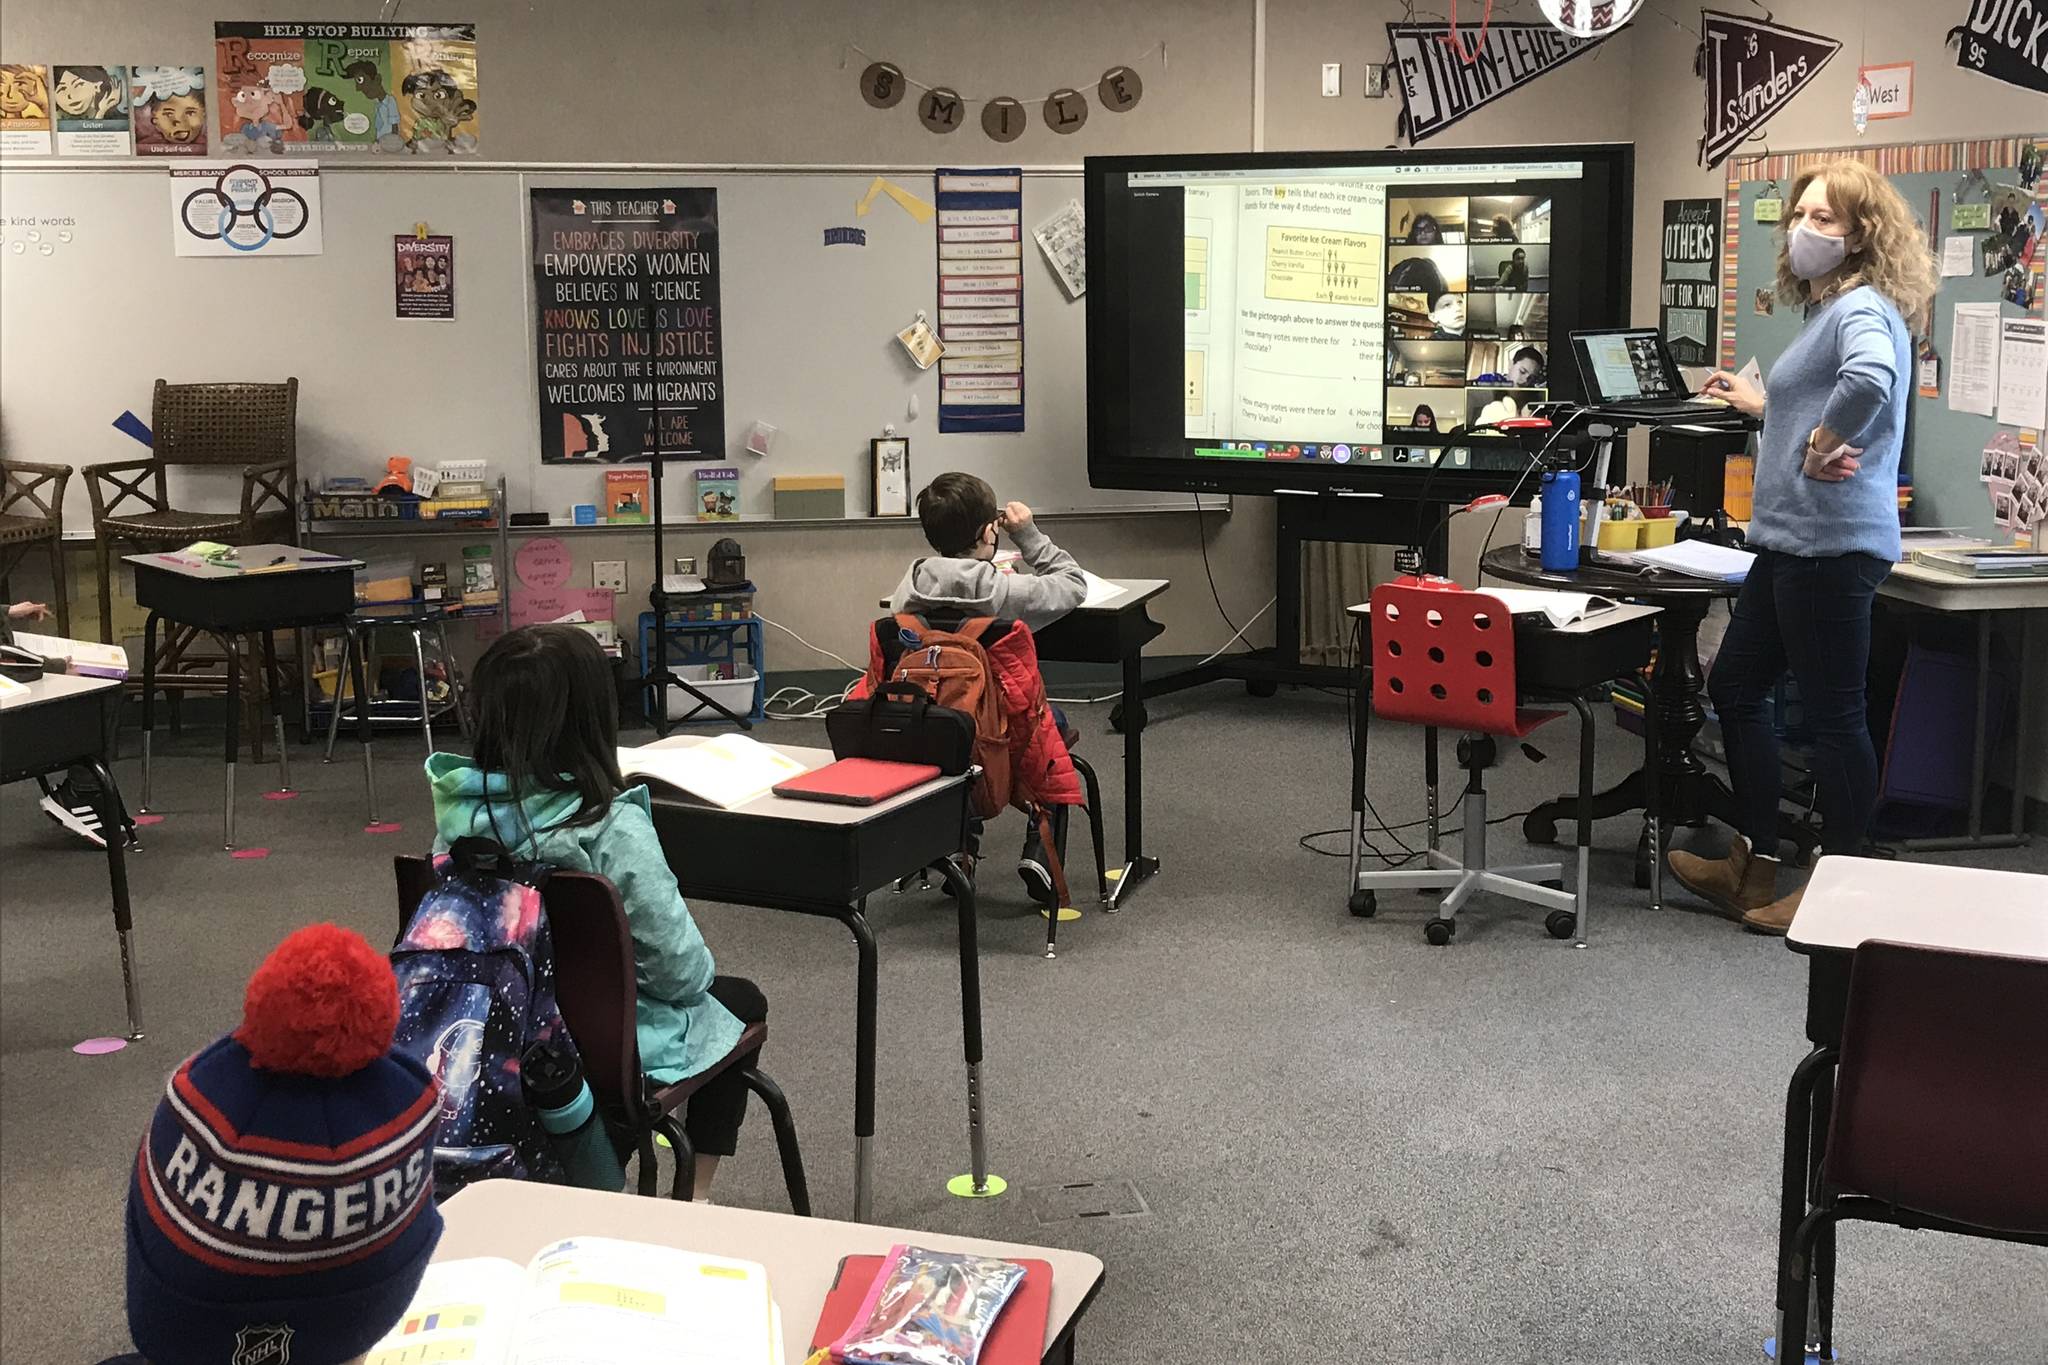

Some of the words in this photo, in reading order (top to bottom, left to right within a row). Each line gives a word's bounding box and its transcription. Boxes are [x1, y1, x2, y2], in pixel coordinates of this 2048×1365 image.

[264, 25, 303, 37] HELP
[308, 26, 346, 37] STOP
[351, 26, 429, 38] BULLYING
[315, 39, 380, 76] Report
[1869, 84, 1900, 105] West
[1275, 187, 1285, 199] key
[1288, 189, 1301, 197] tells
[1303, 190, 1317, 199] that
[1320, 190, 1335, 201] each
[1337, 192, 1345, 201] ice
[1347, 194, 1367, 204] cream
[1369, 196, 1384, 205] cone
[590, 200, 611, 216] THIS
[617, 201, 659, 216] TEACHER
[1259, 201, 1268, 210] for
[1269, 201, 1279, 210] the
[1281, 203, 1294, 213] way
[1296, 202, 1301, 210] 4
[1302, 204, 1331, 214] students
[11, 216, 36, 226] kind
[40, 216, 76, 226] words
[397, 241, 450, 254] DIVERSITY
[553, 231, 625, 251] EMBRACES
[633, 230, 700, 250] DIVERSITY
[1281, 233, 1308, 243] Favorite
[1310, 235, 1319, 244] Ice
[1321, 236, 1342, 246] Cream
[1343, 238, 1367, 248] Flavors
[1665, 223, 1714, 260] OTHERS
[544, 253, 637, 276] EMPOWERS
[646, 253, 710, 276] WOMEN
[556, 282, 617, 302] BELIEVES
[626, 282, 639, 301] IN
[1661, 284, 1675, 306] NOT
[1679, 284, 1693, 307] FOR
[1697, 284, 1717, 308] WHO
[544, 309, 600, 329] KNOWS
[609, 308, 645, 329] LOVE
[677, 307, 713, 329] LOVE
[1258, 311, 1292, 324] pictograph
[1293, 315, 1314, 325] above
[1316, 317, 1324, 325] to
[1324, 319, 1349, 327] answer
[1350, 319, 1361, 328] the
[546, 332, 609, 358] FIGHTS
[1256, 330, 1272, 341] many
[1274, 333, 1290, 342] votes
[1292, 335, 1310, 344] were
[1310, 336, 1329, 345] there
[1330, 336, 1340, 346] for
[1352, 338, 1358, 347] 2.
[1360, 339, 1371, 348] How
[1359, 352, 1374, 361] their
[545, 362, 578, 378] CARES
[583, 362, 617, 378] ABOUT
[622, 362, 640, 377] THE
[548, 383, 625, 404] WELCOMES
[1254, 399, 1269, 411] many
[1271, 404, 1288, 412] votes
[1289, 406, 1306, 414] were
[1307, 406, 1325, 416] there
[1327, 407, 1336, 416] for
[1357, 409, 1369, 417] How
[648, 416, 665, 430] AL
[671, 415, 689, 430] ARE
[1356, 421, 1365, 430] for
[643, 432, 693, 447] WLCOME
[164, 1132, 425, 1242] RANGERS
[244, 1338, 278, 1365] NHL
